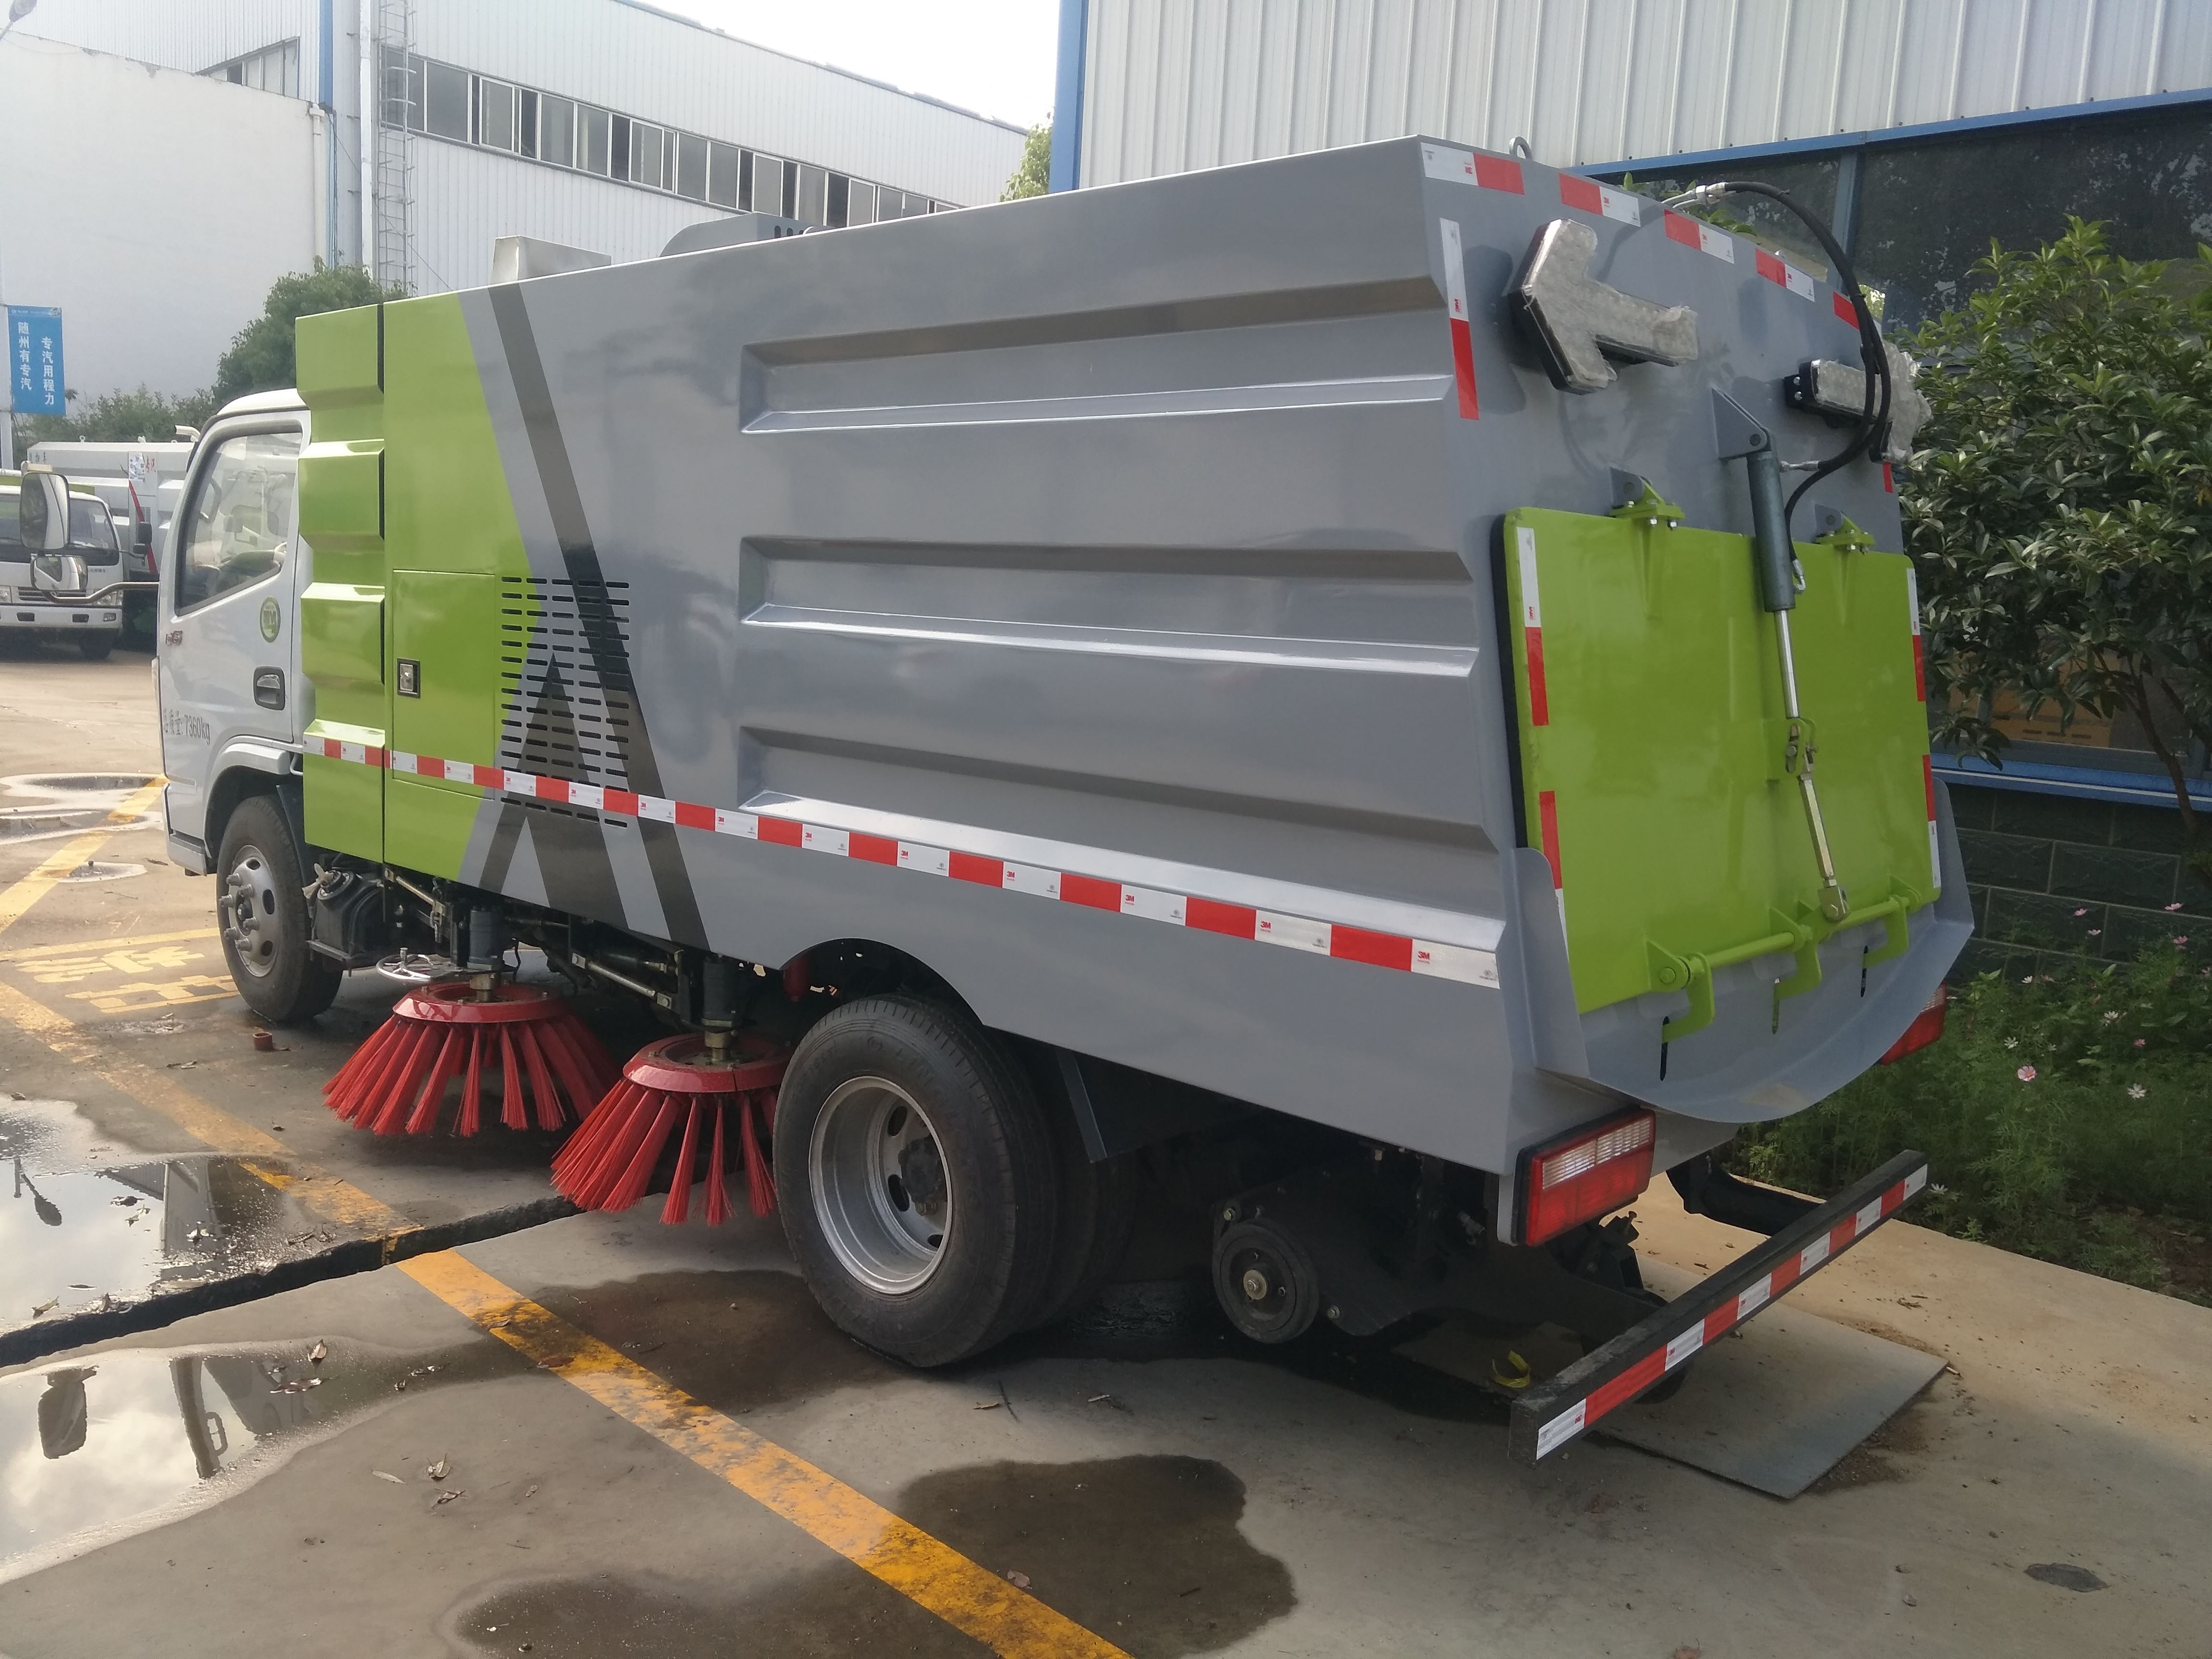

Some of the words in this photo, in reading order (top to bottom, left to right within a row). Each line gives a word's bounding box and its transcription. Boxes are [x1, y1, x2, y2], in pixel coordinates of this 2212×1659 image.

[18, 321, 32, 390] 随州有专汽
[41, 337, 55, 405] 专汽用程力
[1261, 920, 1271, 929] 3M
[1418, 950, 1430, 960] 3M
